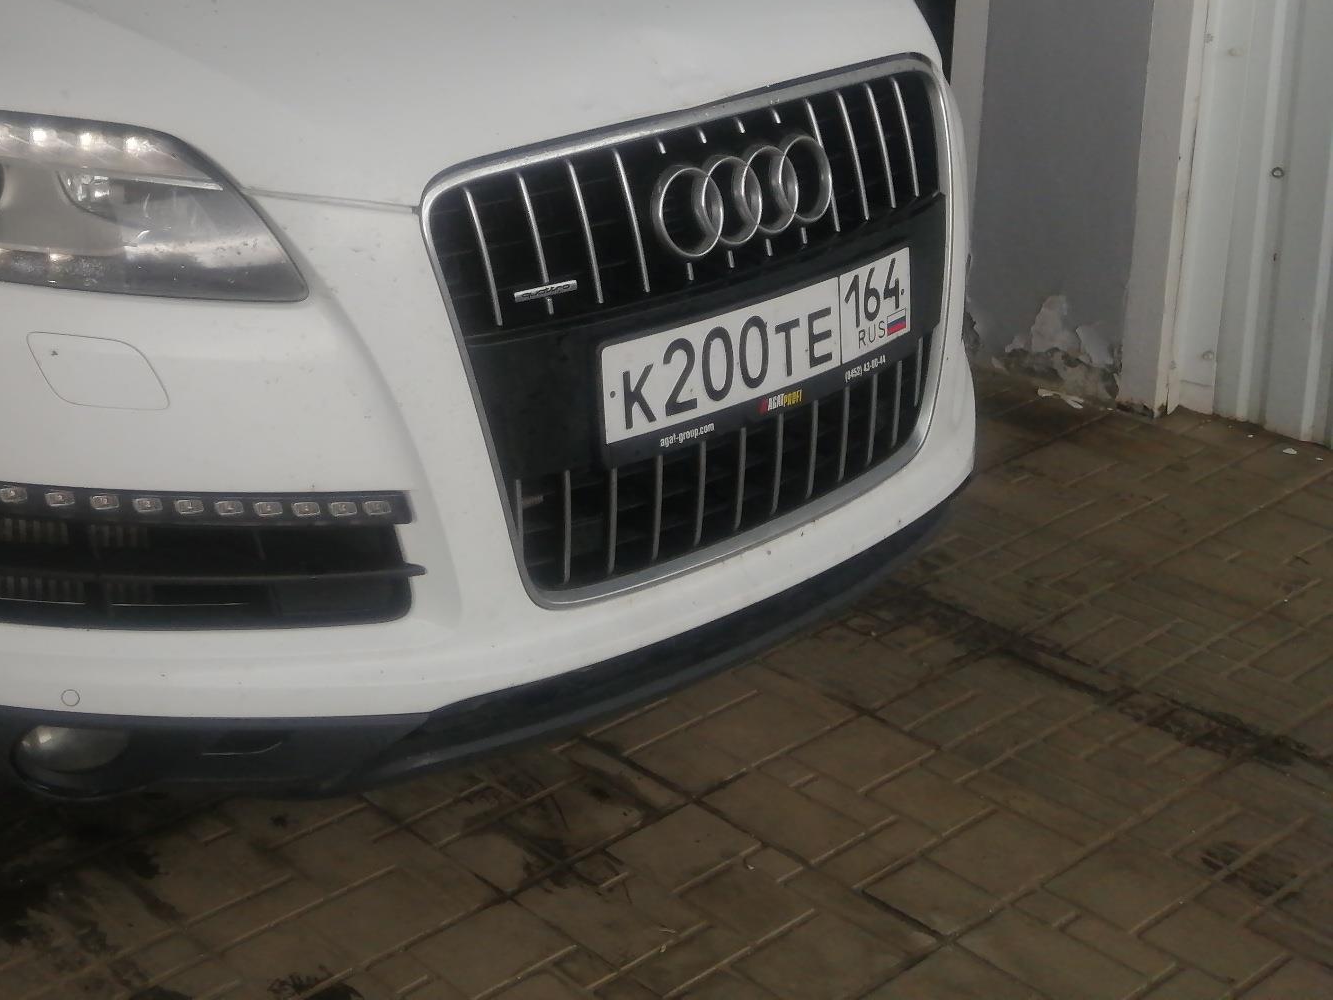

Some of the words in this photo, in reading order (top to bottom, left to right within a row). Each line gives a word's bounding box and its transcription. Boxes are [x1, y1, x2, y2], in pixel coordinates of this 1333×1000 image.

[844, 257, 900, 328] 164
[857, 320, 886, 350] RUS
[659, 422, 715, 448] agat-group.com
